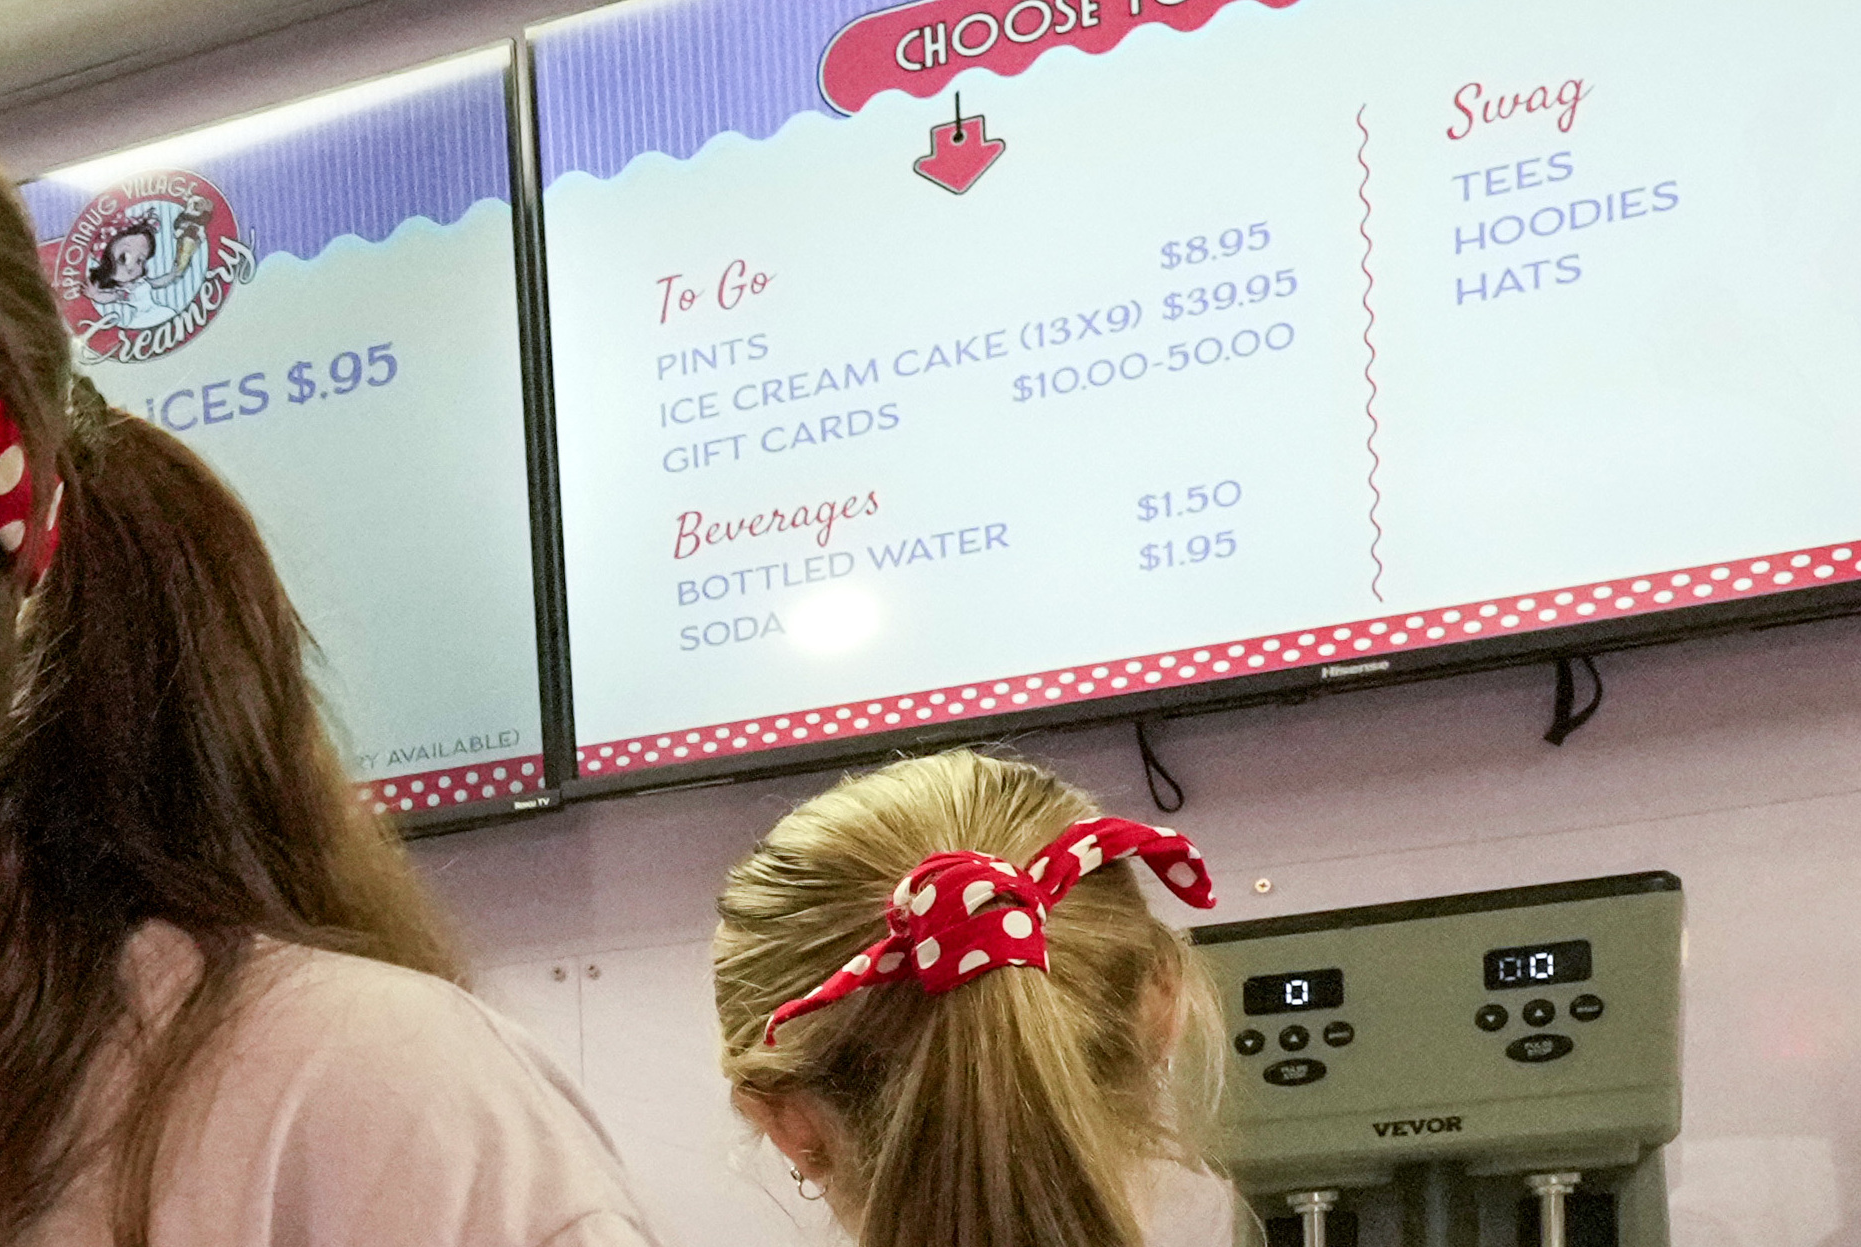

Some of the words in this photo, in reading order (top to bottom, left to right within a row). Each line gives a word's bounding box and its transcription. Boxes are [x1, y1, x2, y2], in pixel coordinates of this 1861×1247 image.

[895, 0, 1101, 71] CHOOSE
[1446, 78, 1594, 140] Swag
[1451, 151, 1574, 202] TEES
[61, 196, 119, 301] APPONAUG
[1455, 180, 1679, 255] HOODIES
[78, 226, 257, 365] Creamery
[656, 273, 705, 324] To
[717, 259, 777, 310] Go
[656, 332, 770, 380] PINTS
[1160, 221, 1271, 270] $8.95
[1456, 253, 1581, 305] HATS
[287, 341, 398, 405] $.95
[659, 392, 720, 428] ICE
[732, 358, 880, 411] CREAM
[893, 329, 1009, 377] CAKE
[1020, 299, 1143, 351] (13X9)
[1162, 268, 1298, 321] $39.95
[662, 434, 747, 473] GIFT
[760, 403, 900, 453] CARDS
[1012, 322, 1295, 402] $10.00-50.00
[673, 491, 879, 560] Beverages
[677, 552, 855, 606] BOTTLED
[866, 523, 1011, 571] WATER
[1137, 480, 1242, 522] $1.50
[680, 611, 786, 652] SODA
[1139, 530, 1238, 571] $1.95
[387, 729, 520, 768] AVAILABLE)
[1373, 1116, 1463, 1138] VEVOR
